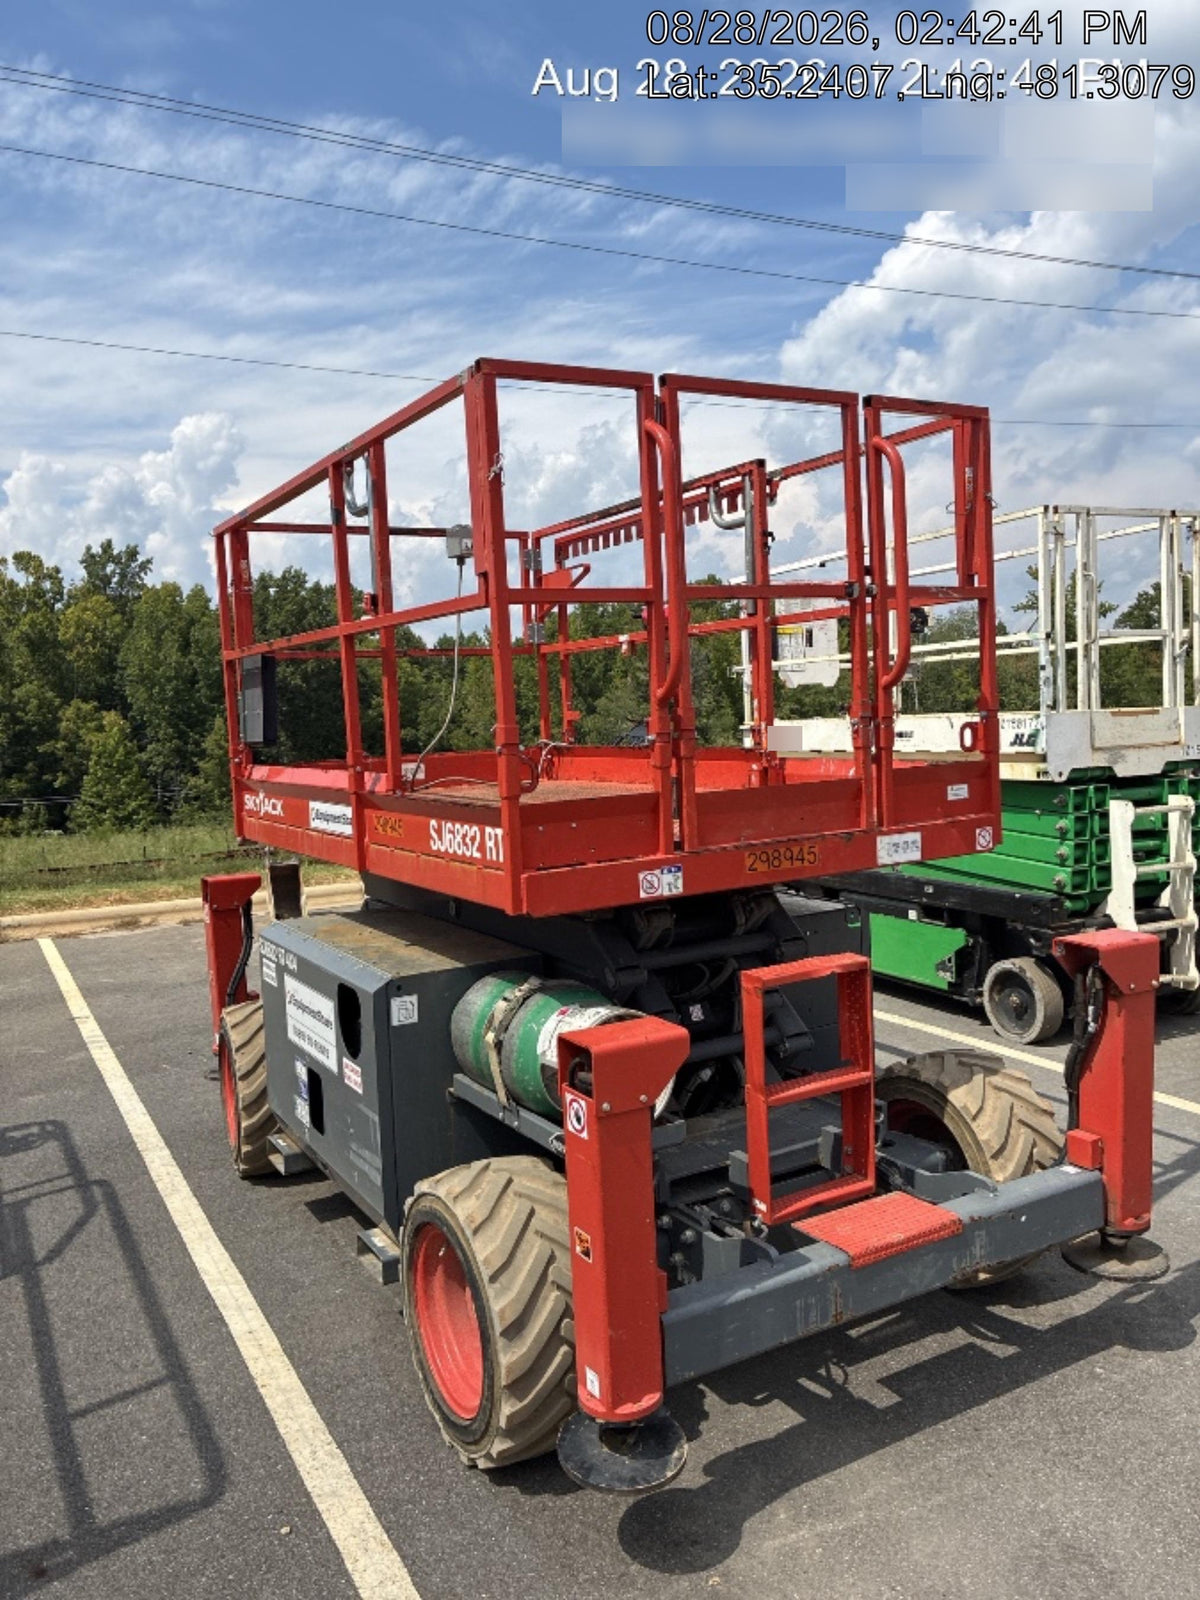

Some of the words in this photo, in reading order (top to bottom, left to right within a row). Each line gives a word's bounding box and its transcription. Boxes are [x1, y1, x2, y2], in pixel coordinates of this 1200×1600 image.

[429, 819, 482, 859] SJ6832
[485, 826, 504, 863] RT
[747, 845, 817, 872] 298945
